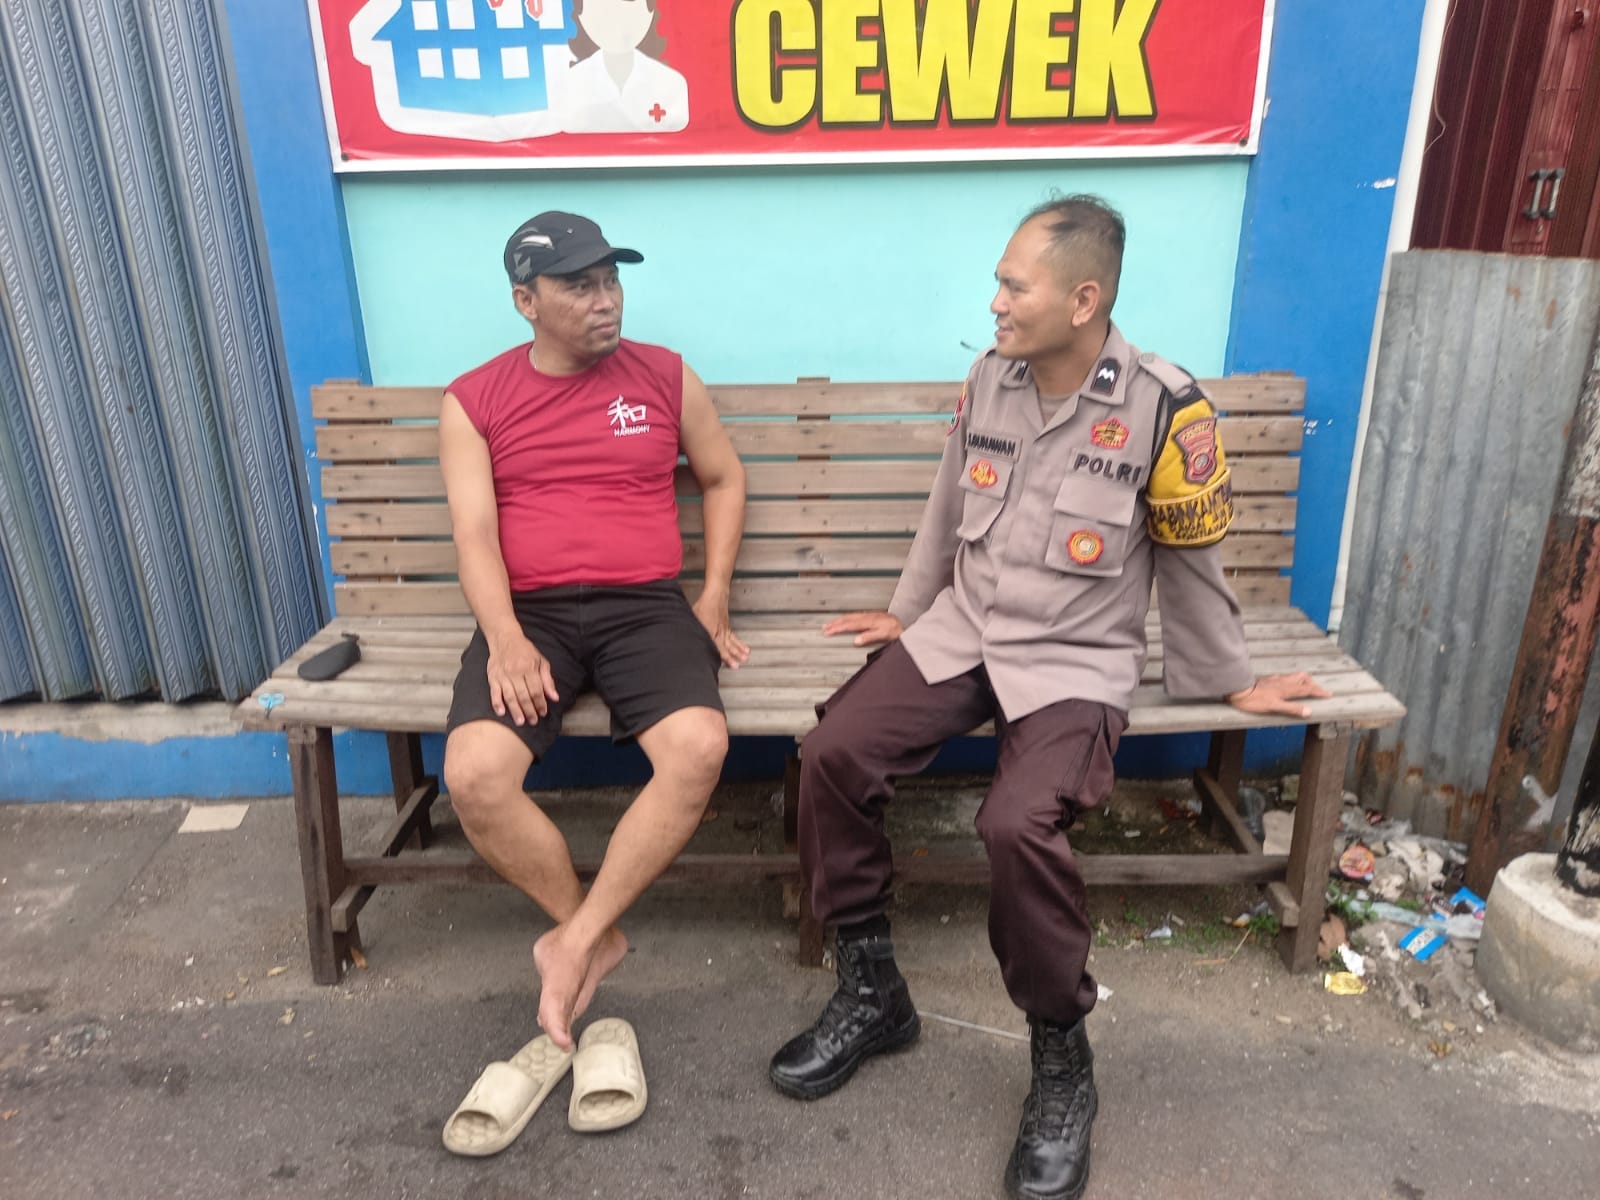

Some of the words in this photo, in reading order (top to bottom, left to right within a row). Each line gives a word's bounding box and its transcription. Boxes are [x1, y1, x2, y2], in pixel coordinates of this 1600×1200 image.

[732, 0, 1157, 130] CEWEK
[607, 394, 647, 428] 和
[613, 424, 651, 438] HARMONY
[1073, 453, 1142, 484] POLRI
